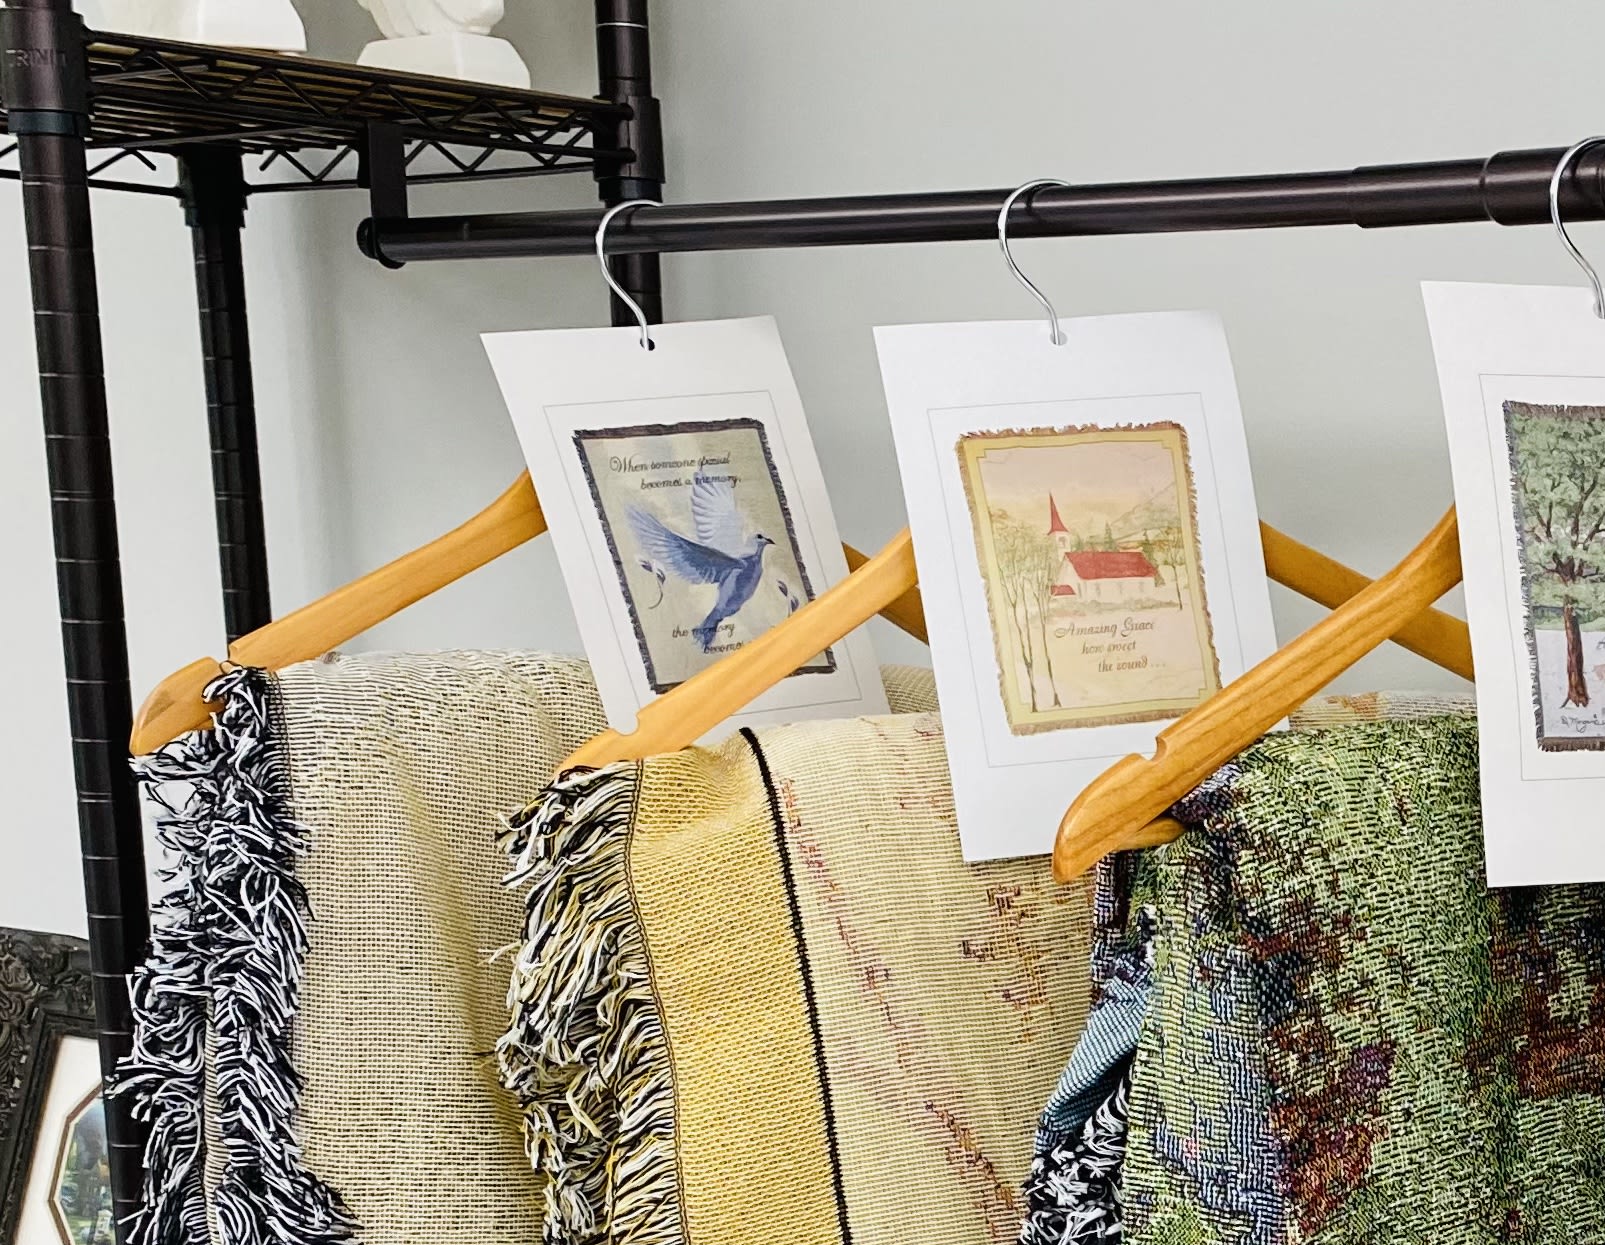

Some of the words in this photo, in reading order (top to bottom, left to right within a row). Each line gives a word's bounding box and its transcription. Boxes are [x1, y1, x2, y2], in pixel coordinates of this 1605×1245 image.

[672, 624, 689, 638] the
[1055, 622, 1117, 638] Amazing
[1121, 616, 1155, 637] Grace
[1081, 642, 1103, 655] how
[1106, 640, 1138, 652] sweet
[1098, 659, 1113, 672] the
